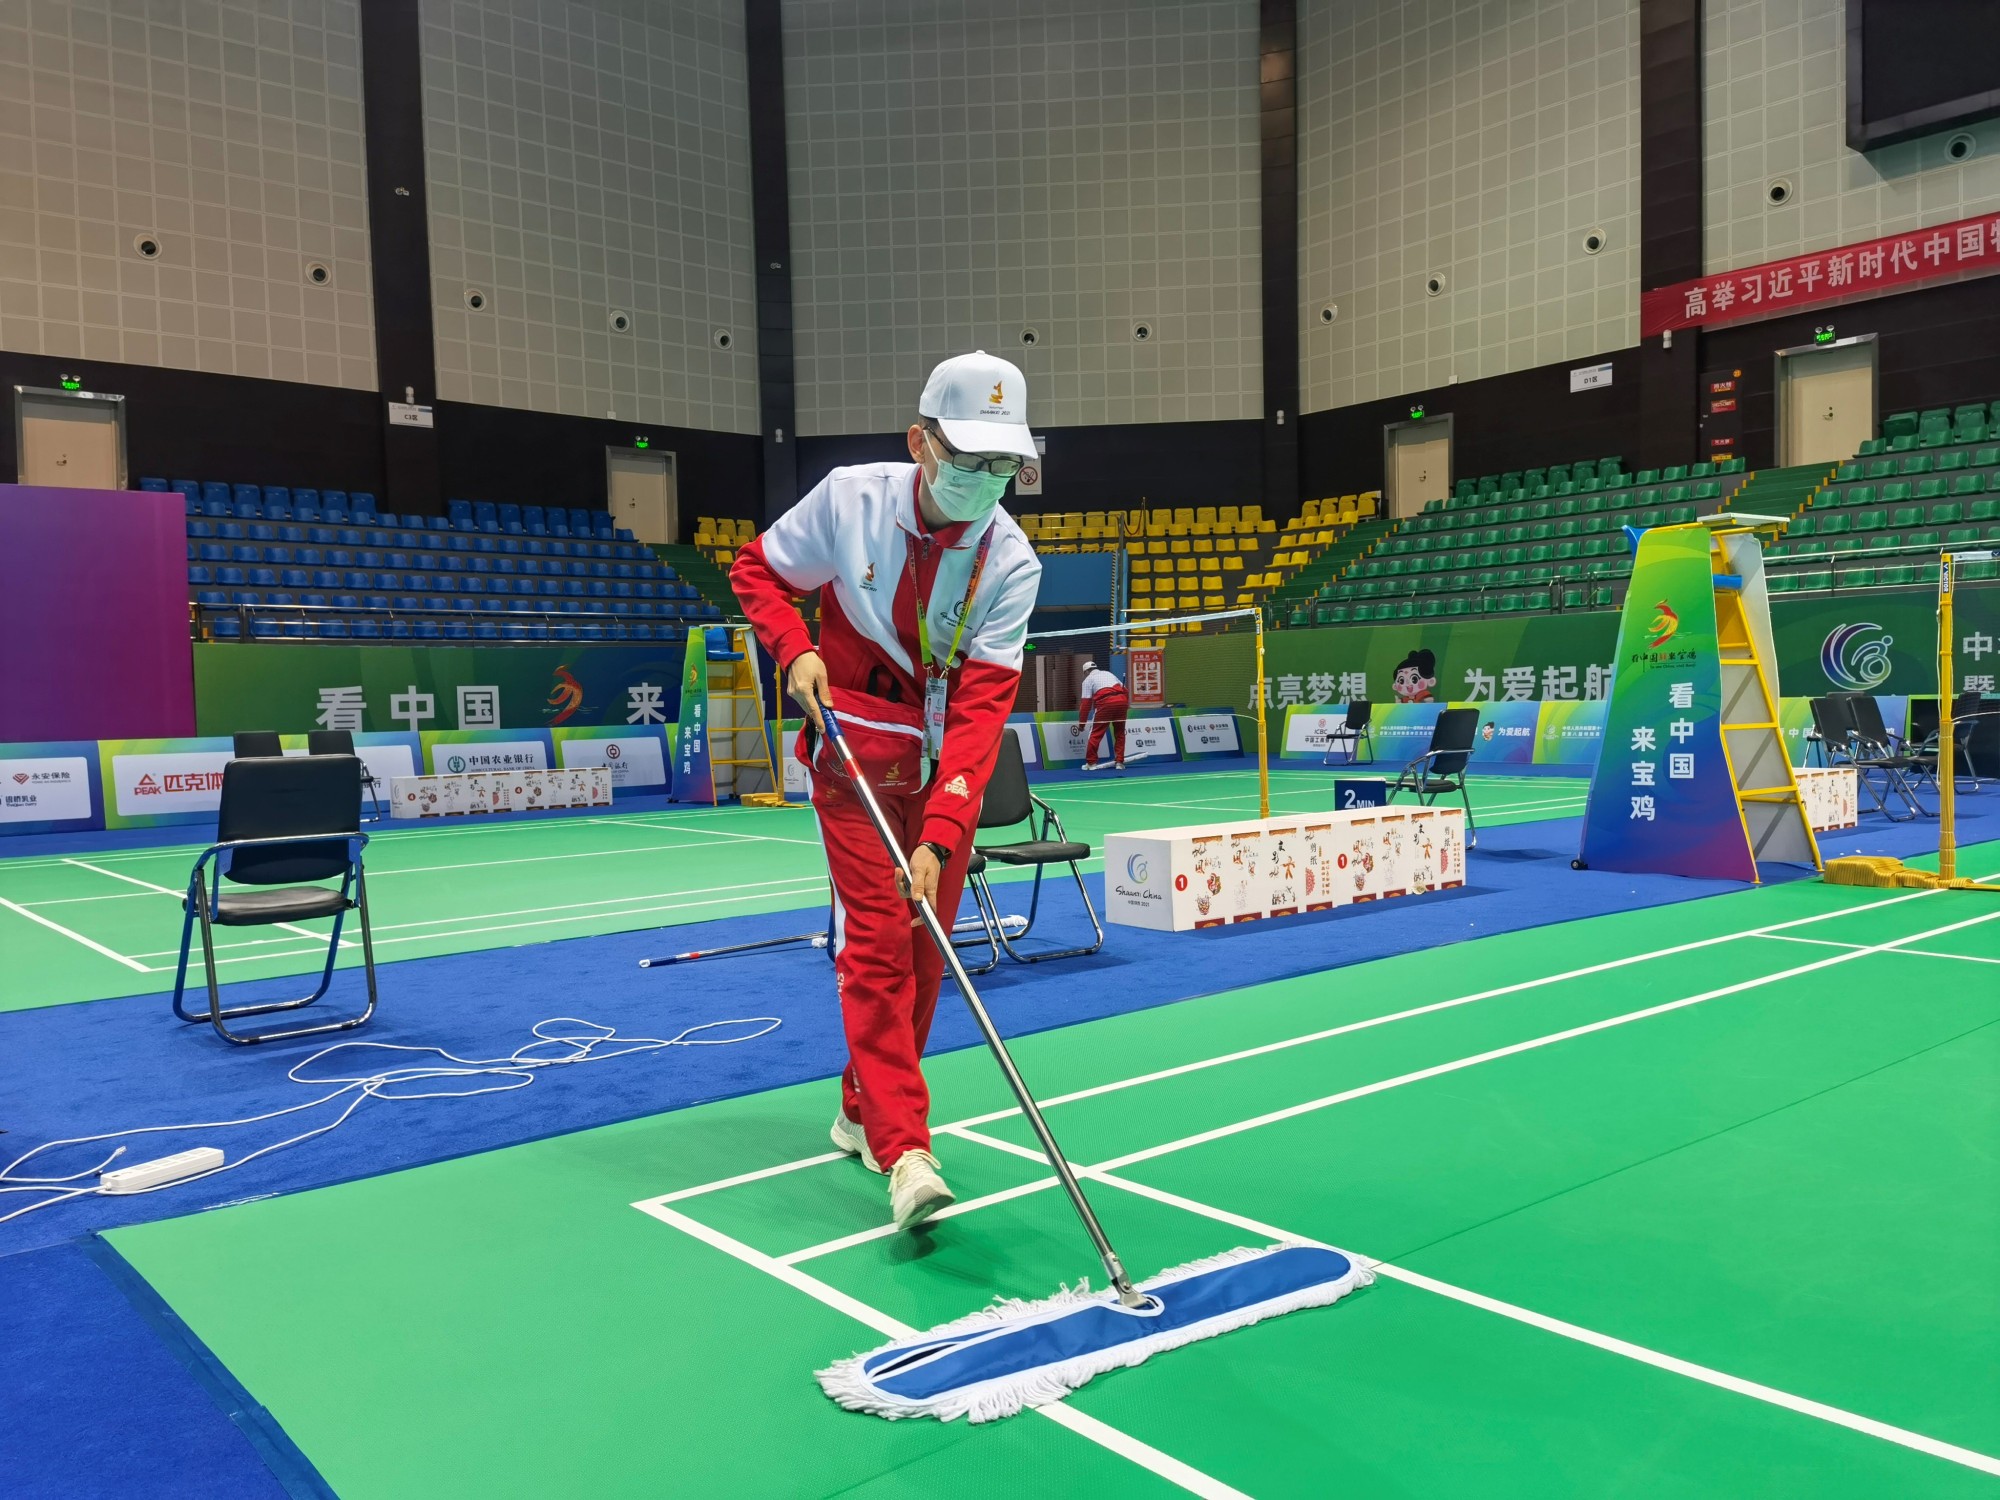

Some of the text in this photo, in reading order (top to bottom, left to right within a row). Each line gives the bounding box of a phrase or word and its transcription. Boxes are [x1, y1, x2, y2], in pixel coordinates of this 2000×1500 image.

[1963, 631, 2000, 661] 中
[1247, 672, 1368, 710] 点亮梦想
[1464, 664, 1615, 702] 为爱起航
[316, 682, 666, 731] 看中国 来
[693, 704, 701, 753] 看中国
[1498, 727, 1530, 736] 为爱起航
[1669, 682, 1695, 779] 看中国
[469, 754, 533, 765] 中国农业银行
[683, 726, 692, 774] 来宝鸡
[164, 772, 223, 792] 匹克体
[1630, 726, 1656, 821] 来宝鸡
[134, 786, 161, 795] PEAK
[944, 784, 970, 799] PEAK
[1344, 789, 1375, 809] 2 MIN
[1143, 889, 1162, 900] China
